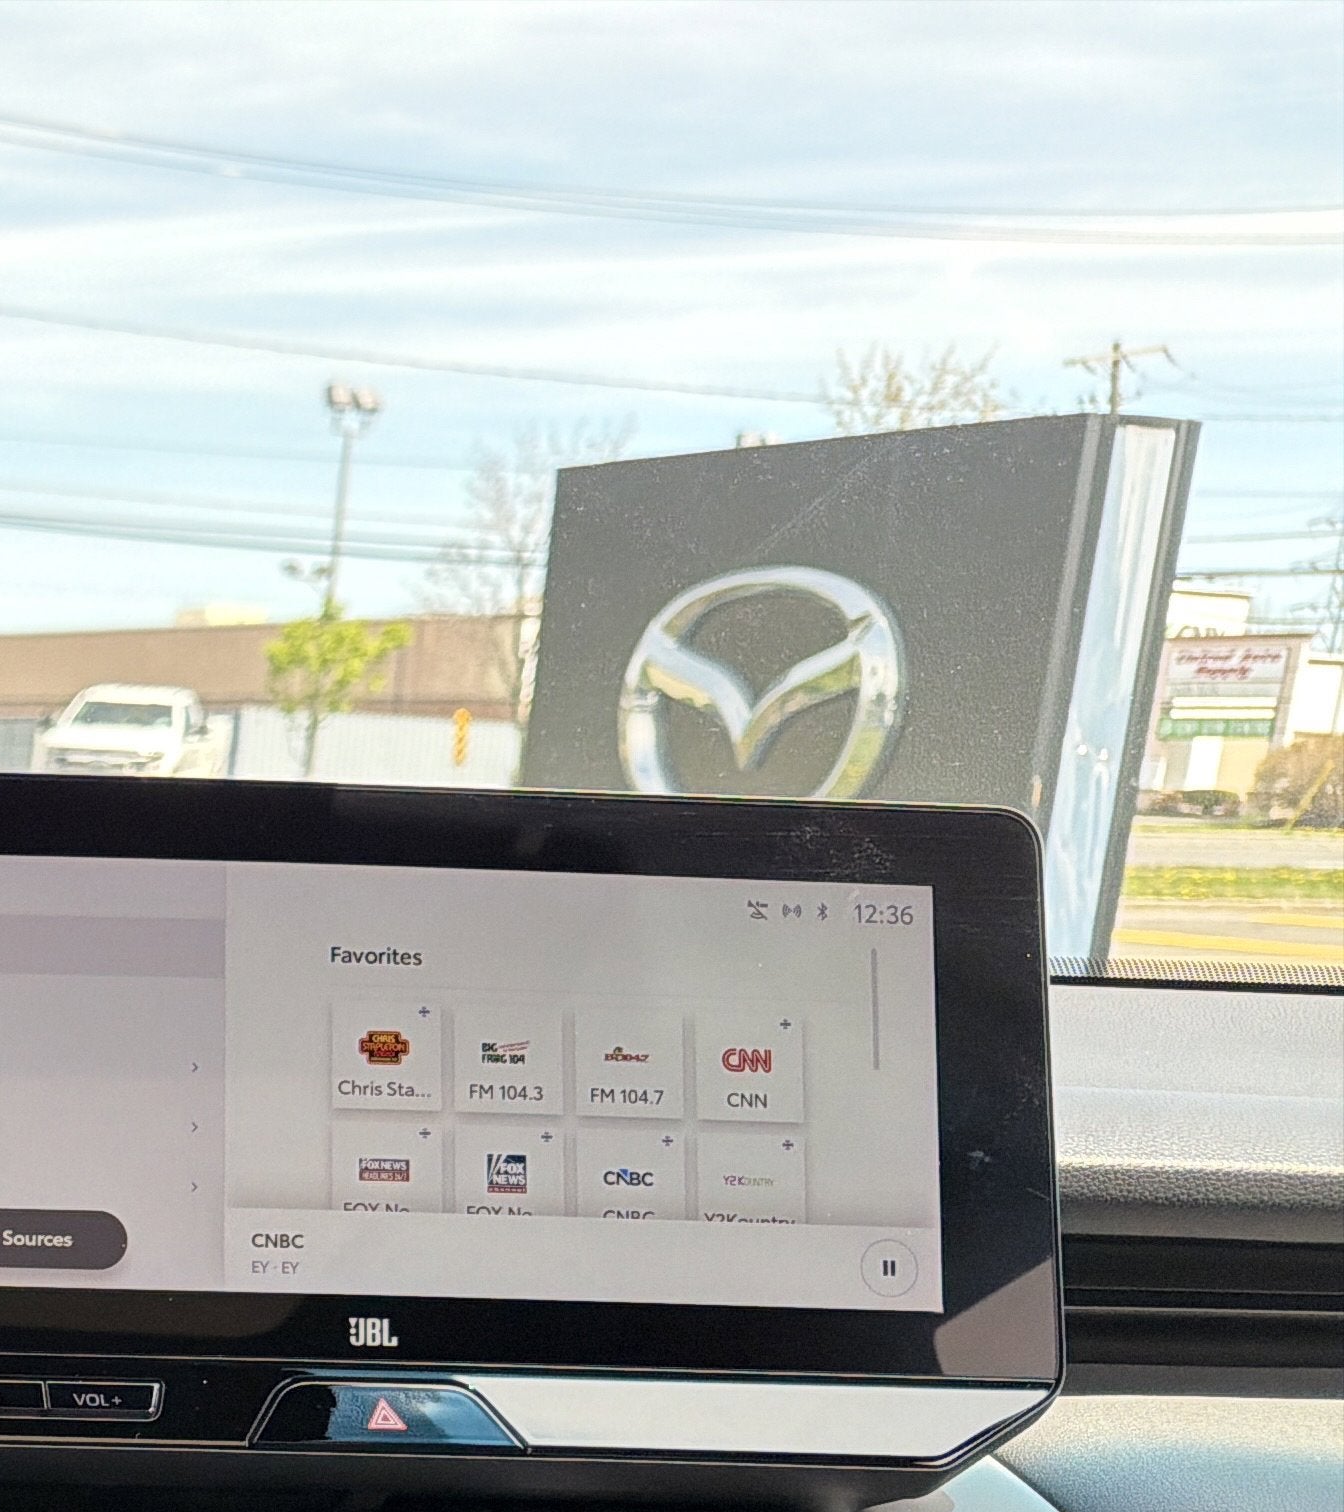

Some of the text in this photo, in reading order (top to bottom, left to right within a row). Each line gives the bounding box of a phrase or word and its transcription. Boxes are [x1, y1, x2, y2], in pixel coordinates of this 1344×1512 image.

[853, 904, 913, 925] 12:36
[329, 945, 423, 967] Favorites
[721, 1048, 772, 1073] CNN
[338, 1080, 431, 1098] Chris Sta...
[470, 1084, 544, 1101] FM 104.3
[590, 1088, 664, 1105] FM 104.7
[727, 1092, 767, 1108] CNN
[499, 1163, 525, 1174] FOX
[492, 1174, 526, 1185] NEWS
[603, 1170, 654, 1187] CNBC
[2, 1229, 73, 1248] Sources
[251, 1233, 305, 1249] CNBC
[251, 1260, 300, 1274] EY EY
[348, 1317, 399, 1346] JBL
